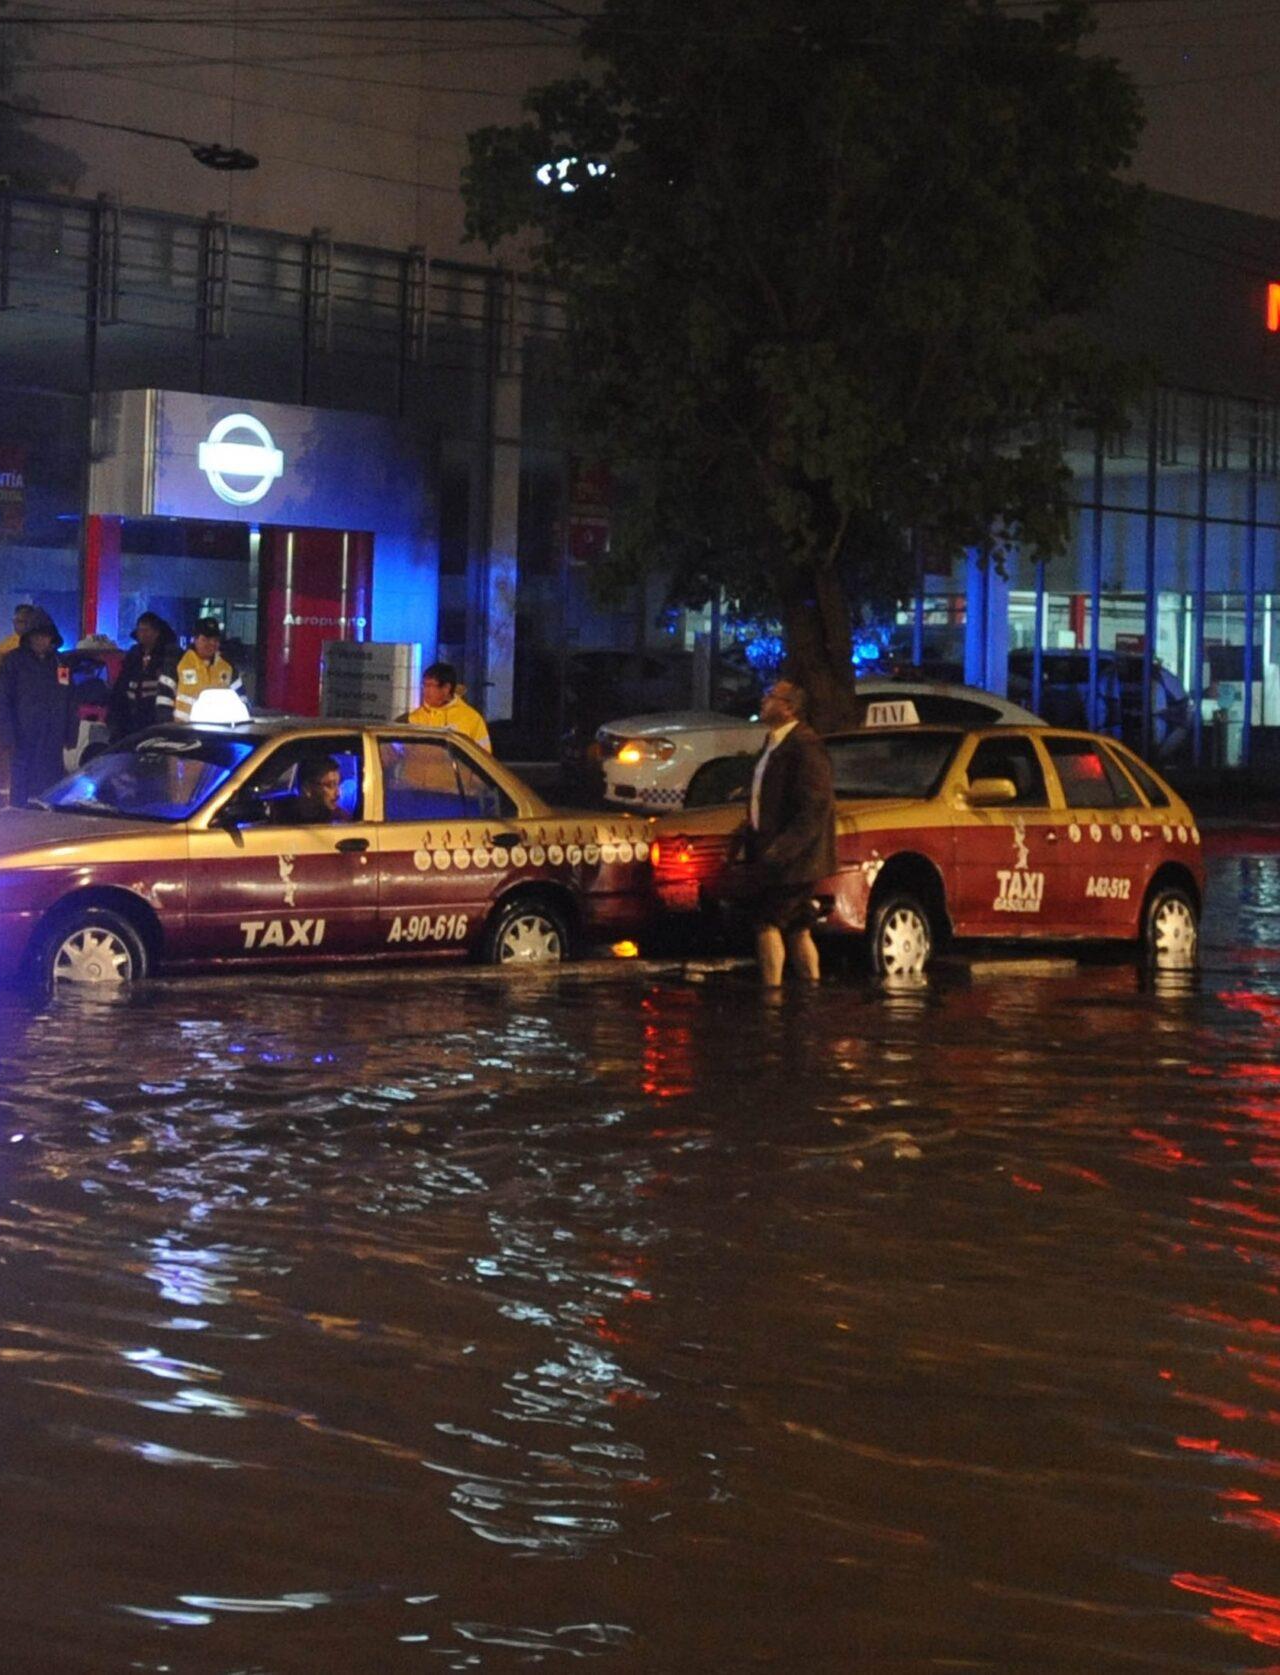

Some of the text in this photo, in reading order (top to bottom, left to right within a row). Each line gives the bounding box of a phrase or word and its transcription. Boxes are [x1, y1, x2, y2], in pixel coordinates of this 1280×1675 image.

[996, 870, 1044, 899] TAXI
[240, 918, 326, 949] TAXI
[386, 914, 468, 943] A-90-616
